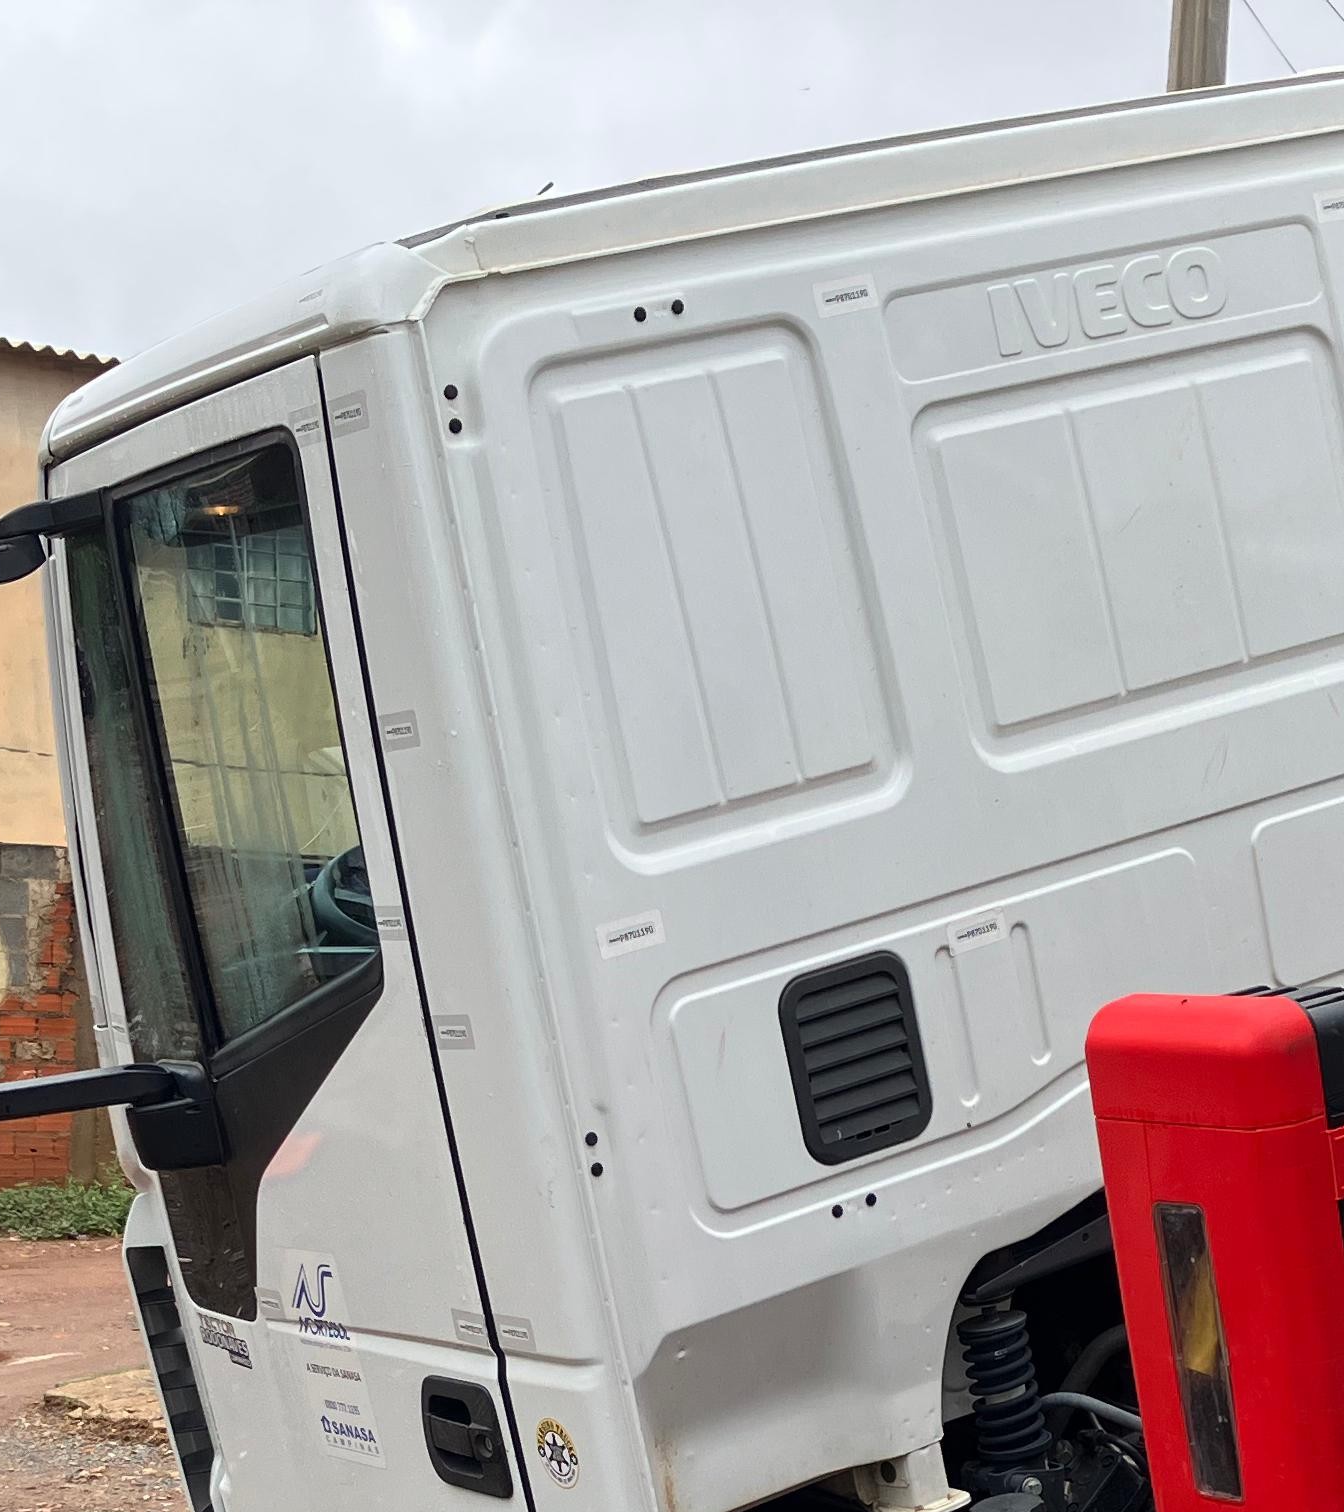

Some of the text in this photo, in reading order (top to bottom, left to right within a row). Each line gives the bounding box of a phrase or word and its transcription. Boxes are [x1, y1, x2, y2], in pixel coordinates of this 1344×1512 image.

[986, 246, 1227, 357] IVECO
[331, 1420, 377, 1444] SANASA
[325, 1434, 380, 1455] CAMPINAS
